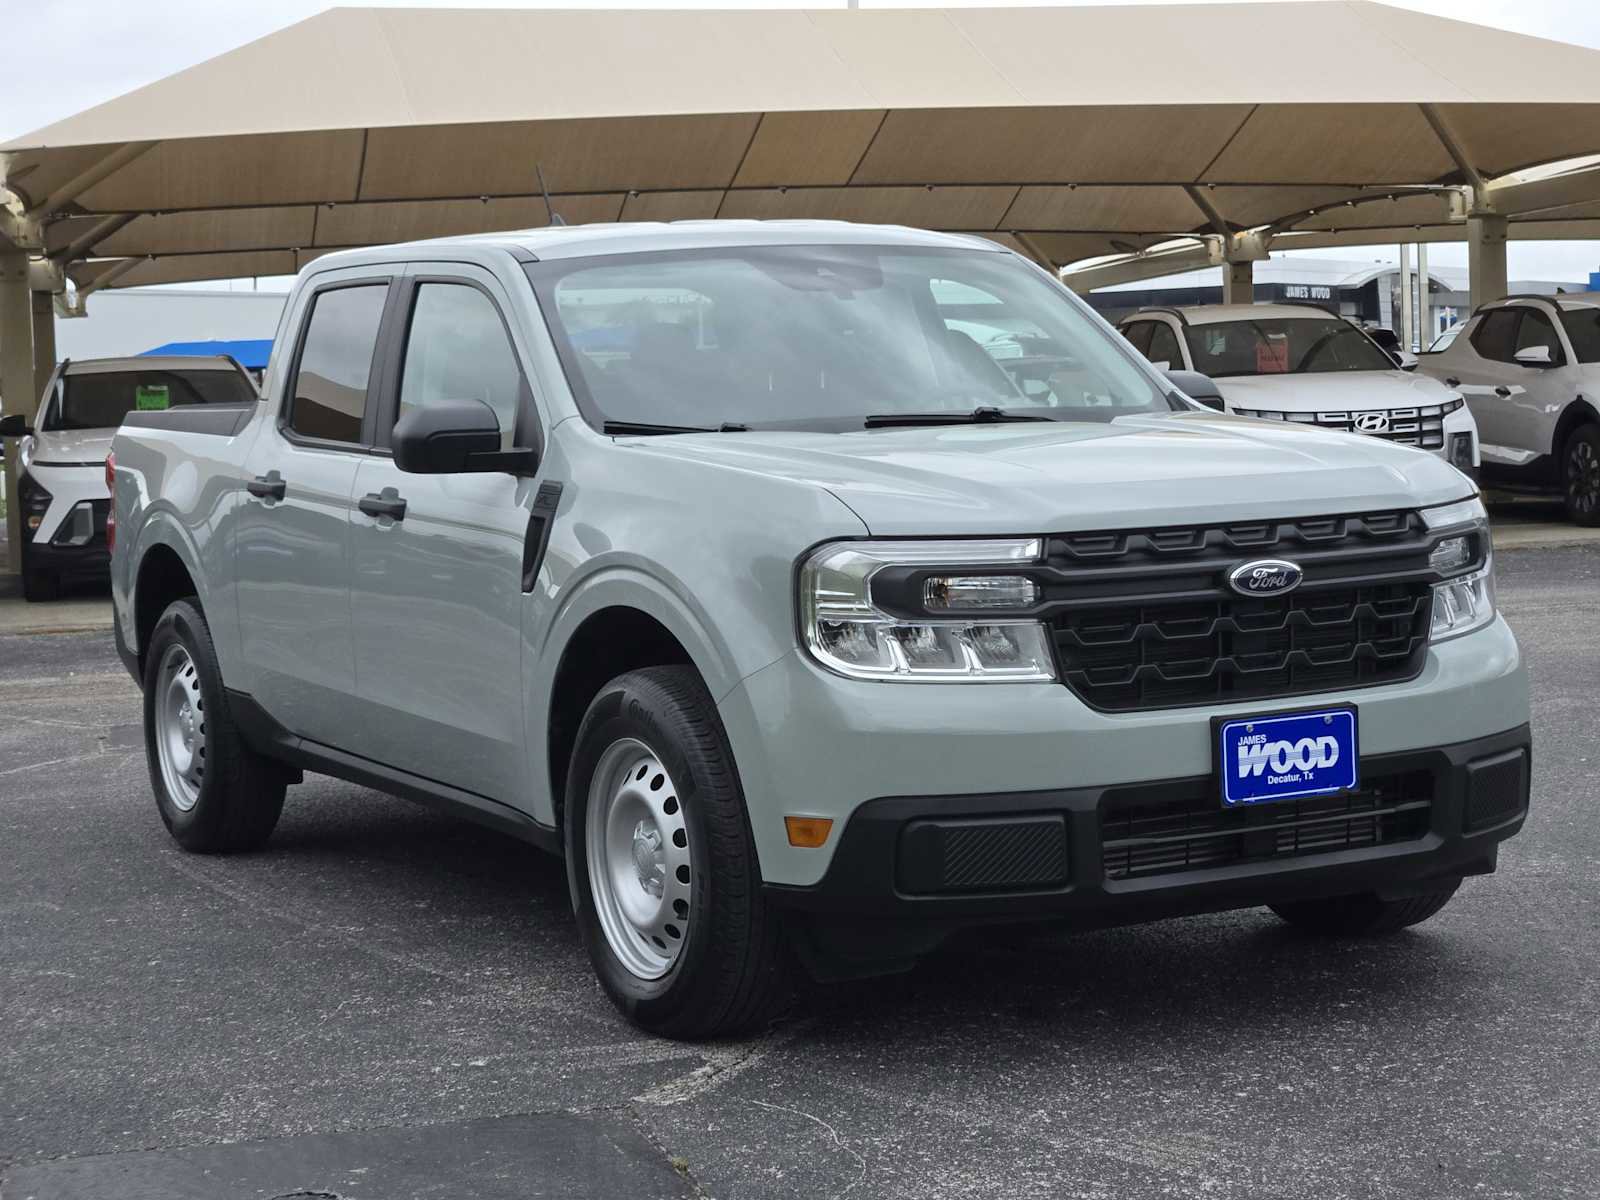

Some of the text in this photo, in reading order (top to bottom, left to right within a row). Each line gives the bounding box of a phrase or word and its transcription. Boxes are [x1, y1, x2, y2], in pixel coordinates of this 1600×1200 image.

[1286, 286, 1330, 299] JAMES WOOD
[1249, 567, 1288, 589] Ford
[1238, 734, 1267, 746] JAMES
[1238, 735, 1340, 778] WOOD
[1267, 771, 1314, 785] Decatur, Tx
